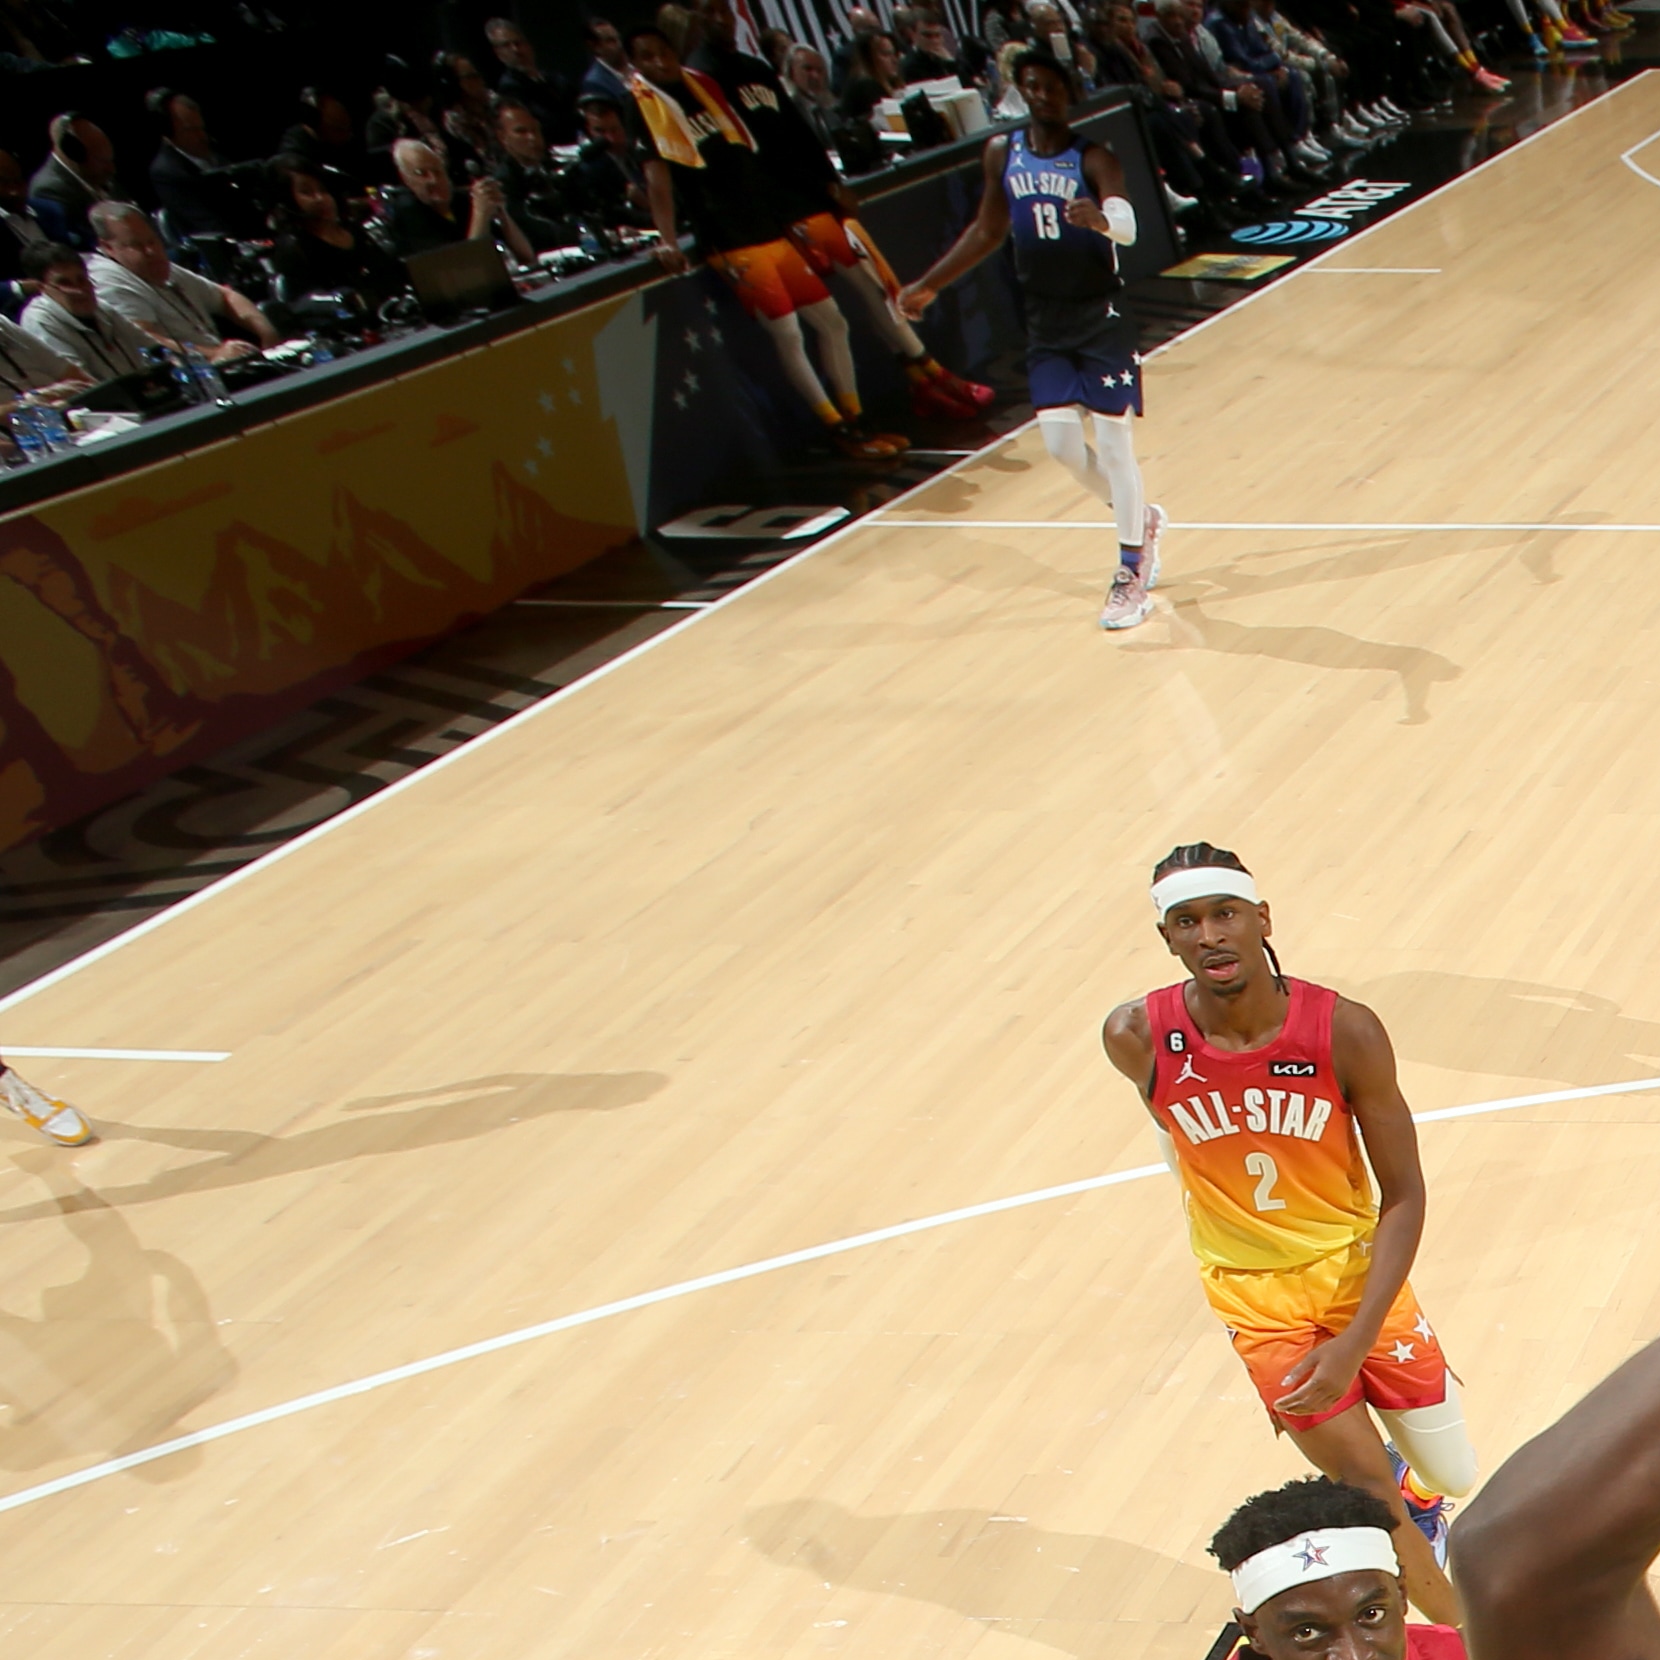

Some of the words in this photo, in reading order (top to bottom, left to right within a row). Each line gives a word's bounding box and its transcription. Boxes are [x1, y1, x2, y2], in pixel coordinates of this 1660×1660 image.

[1294, 179, 1411, 219] AT&T
[1032, 202, 1061, 240] 13
[1170, 1032, 1184, 1051] 6
[1168, 1088, 1332, 1145] ALL-STAR
[1245, 1152, 1287, 1211] 2
